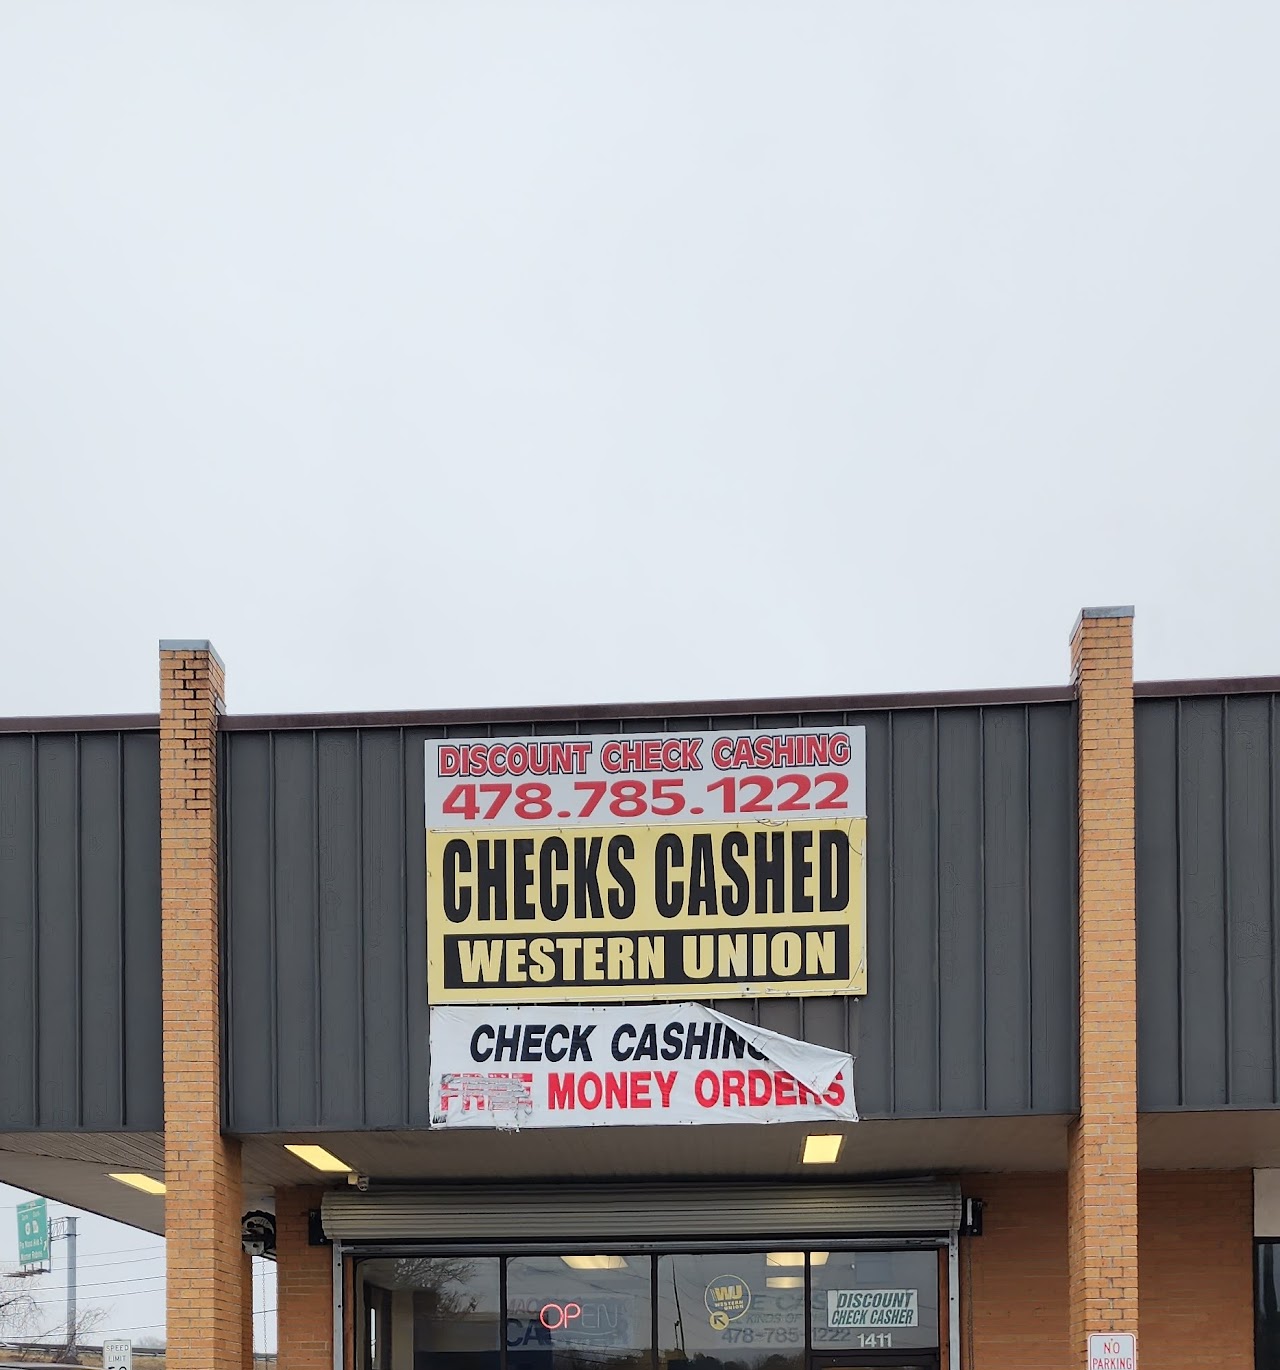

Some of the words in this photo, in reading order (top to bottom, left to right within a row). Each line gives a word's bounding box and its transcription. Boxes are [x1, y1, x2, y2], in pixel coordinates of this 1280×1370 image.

[438, 742, 592, 777] DISCOUNT
[600, 737, 703, 774] CHECK
[711, 732, 851, 769] CASHING
[441, 772, 850, 820] 478.785.1222
[442, 834, 637, 924] CHECKS
[654, 829, 850, 919] CASHED
[457, 935, 666, 984] WESTERN
[682, 930, 837, 978] UNION
[469, 1023, 597, 1063] CHECK
[611, 1021, 769, 1062] CASHIN
[548, 1070, 679, 1110] MONEY
[837, 1292, 914, 1309] DISCOUNT
[540, 1302, 618, 1329] OPEN
[831, 1309, 868, 1325] CHECK
[870, 1309, 914, 1325] CASHER
[106, 1344, 129, 1352] SPEED
[856, 1332, 892, 1348] 1411
[1103, 1341, 1120, 1354] NO
[1092, 1357, 1132, 1370] PARKING
